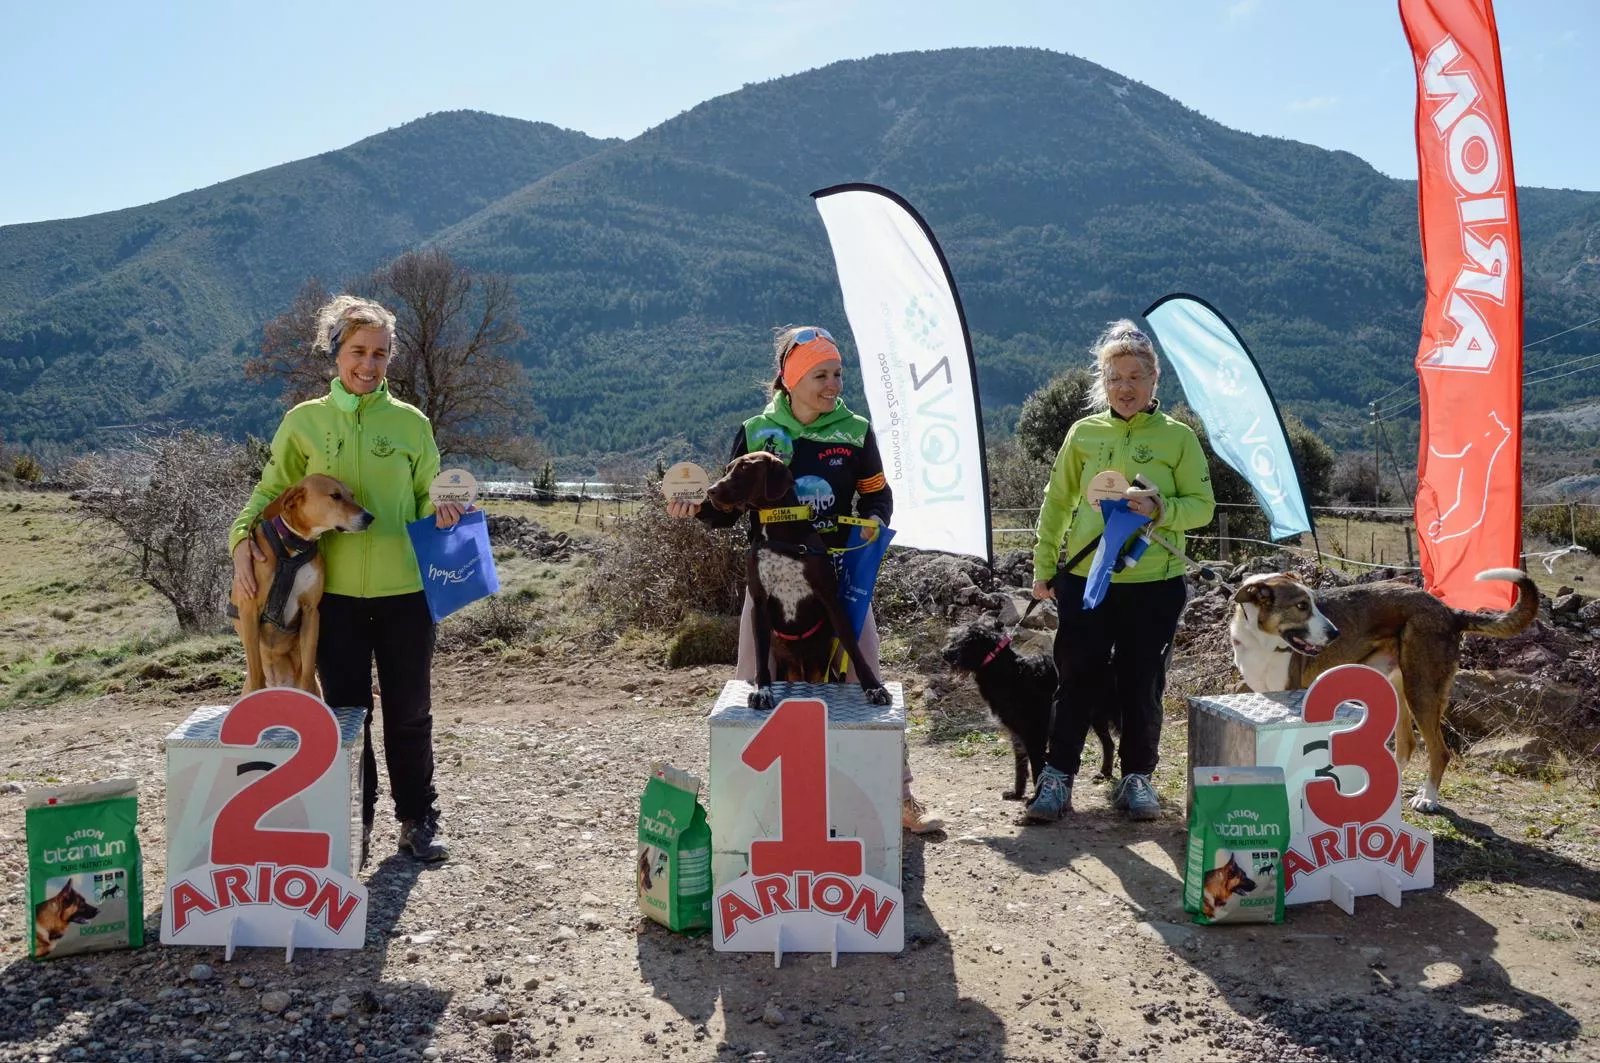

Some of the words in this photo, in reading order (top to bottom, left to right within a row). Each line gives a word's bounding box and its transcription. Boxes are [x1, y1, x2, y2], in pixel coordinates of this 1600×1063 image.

[818, 447, 852, 461] ARION
[772, 508, 791, 516] CIMA
[428, 563, 462, 586] hoya
[1303, 663, 1399, 828] 3
[210, 687, 339, 868] 2
[741, 698, 863, 876] 1
[1227, 809, 1259, 822] ARION
[65, 828, 105, 845] ARION
[43, 839, 127, 864] titanium
[1282, 823, 1429, 895] ARION
[79, 859, 113, 870] NUTRITION
[168, 863, 361, 938] ARION
[717, 871, 898, 944] ARION
